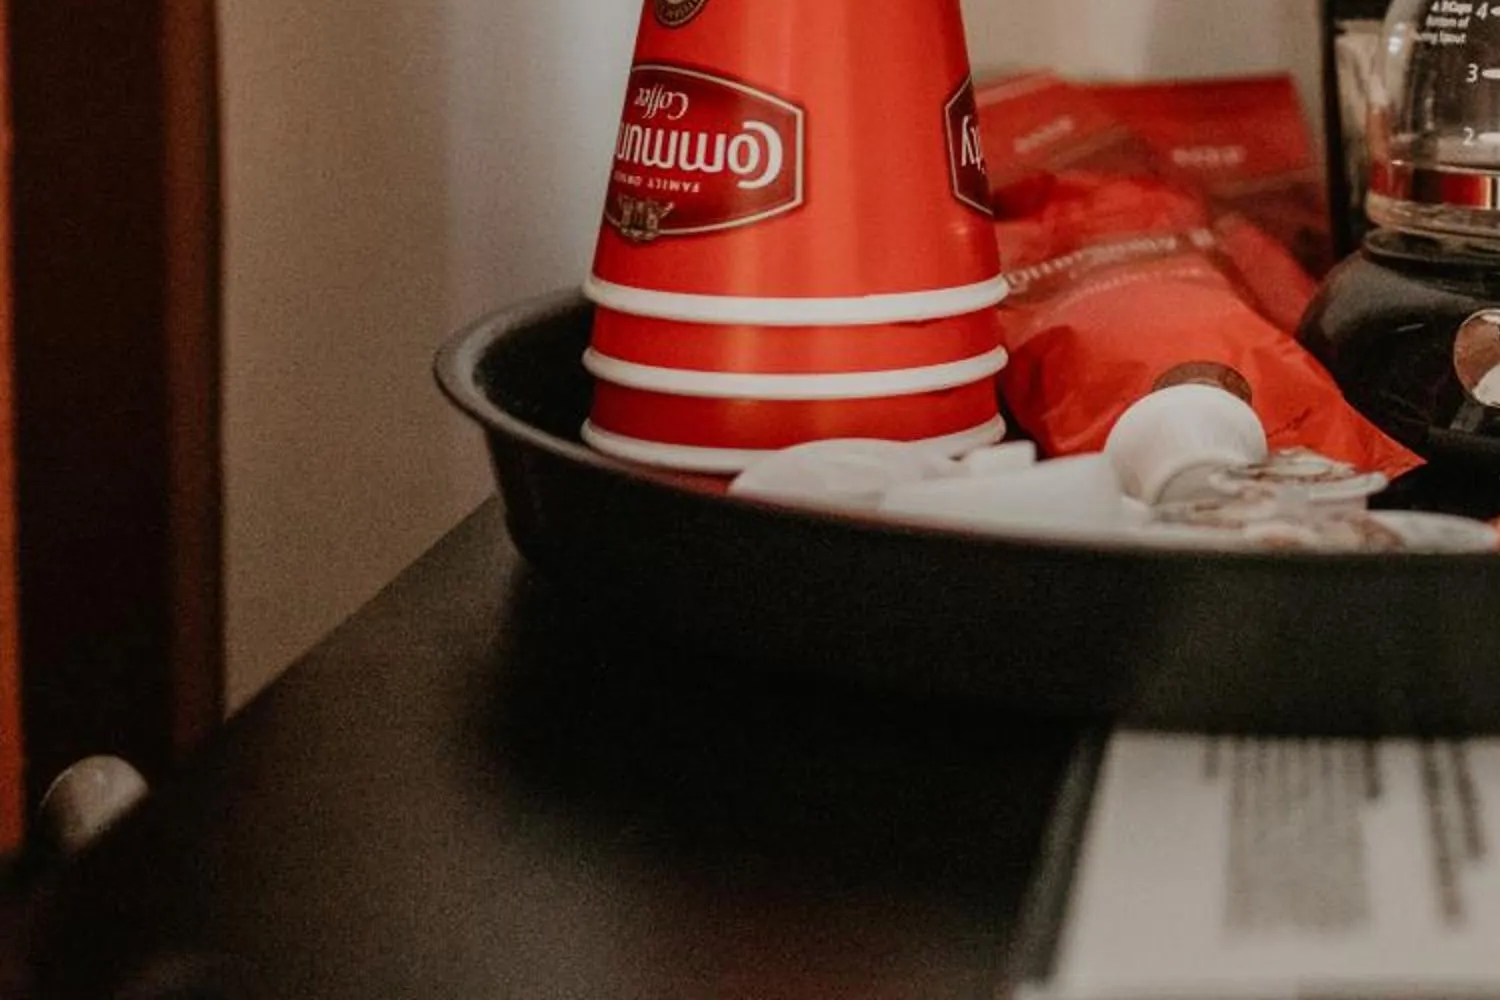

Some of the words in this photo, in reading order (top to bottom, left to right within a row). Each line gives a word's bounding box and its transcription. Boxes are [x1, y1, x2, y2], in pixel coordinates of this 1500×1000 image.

[1475, 1, 1489, 21] 4
[1465, 63, 1479, 83] 3
[634, 84, 690, 120] Coffee
[1462, 126, 1475, 147] 2
[616, 120, 783, 189] Commun
[647, 177, 701, 193] FAMILY
